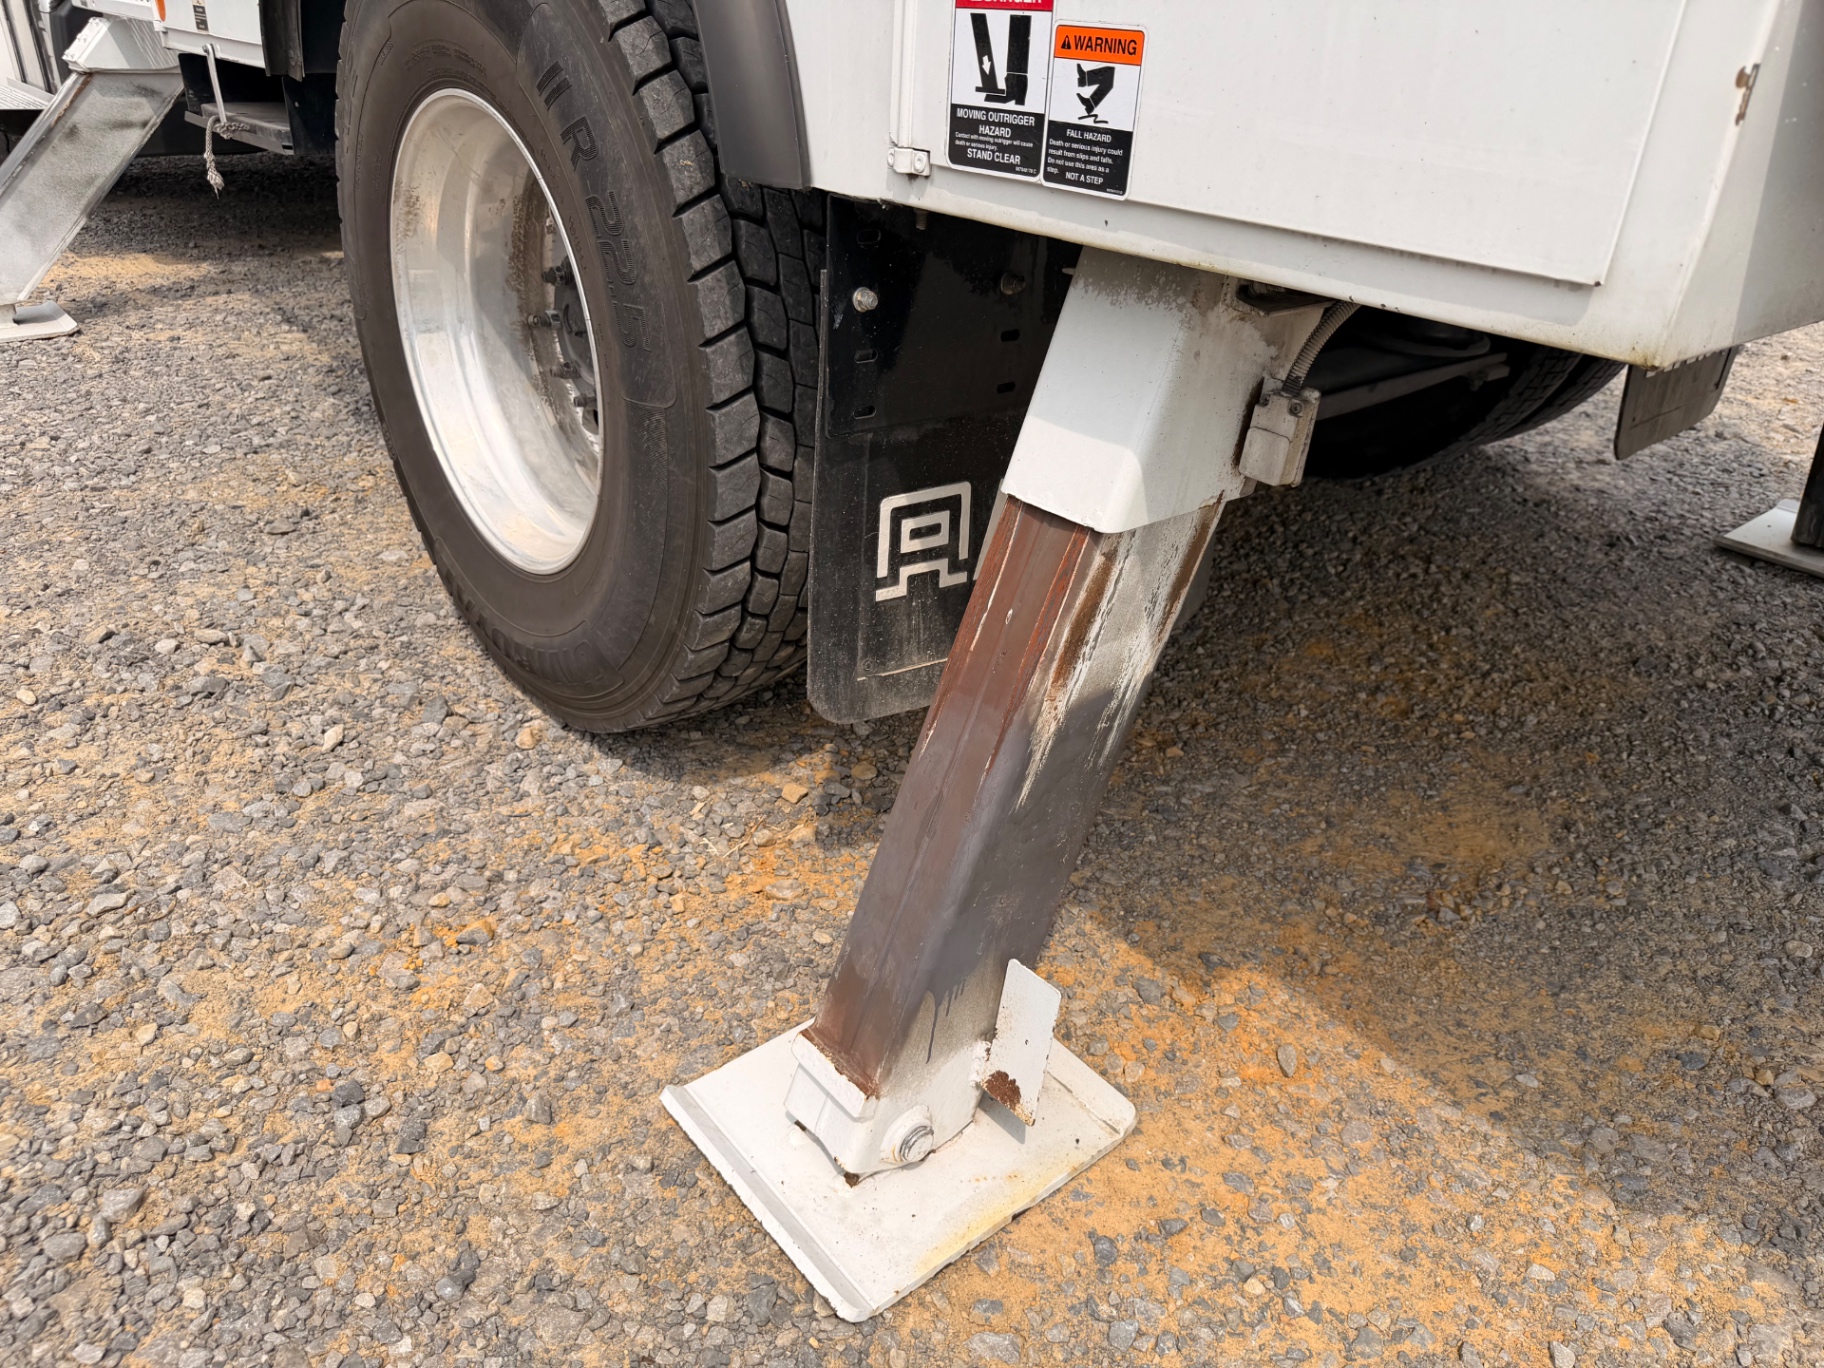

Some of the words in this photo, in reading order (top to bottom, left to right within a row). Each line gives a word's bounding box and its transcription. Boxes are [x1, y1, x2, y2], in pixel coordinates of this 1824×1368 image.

[1074, 34, 1137, 56] WARNING
[956, 108, 986, 120] MOVING
[988, 111, 1035, 126] OUTRIGGER
[979, 125, 1011, 138] HAZARD
[1066, 129, 1082, 139] FALL
[1084, 132, 1112, 142] HAZARD
[967, 148, 992, 160] STAND
[994, 152, 1021, 165] CLEAR
[1091, 146, 1107, 154] injury
[1066, 172, 1079, 181] NOT
[1086, 176, 1103, 184] STEP
